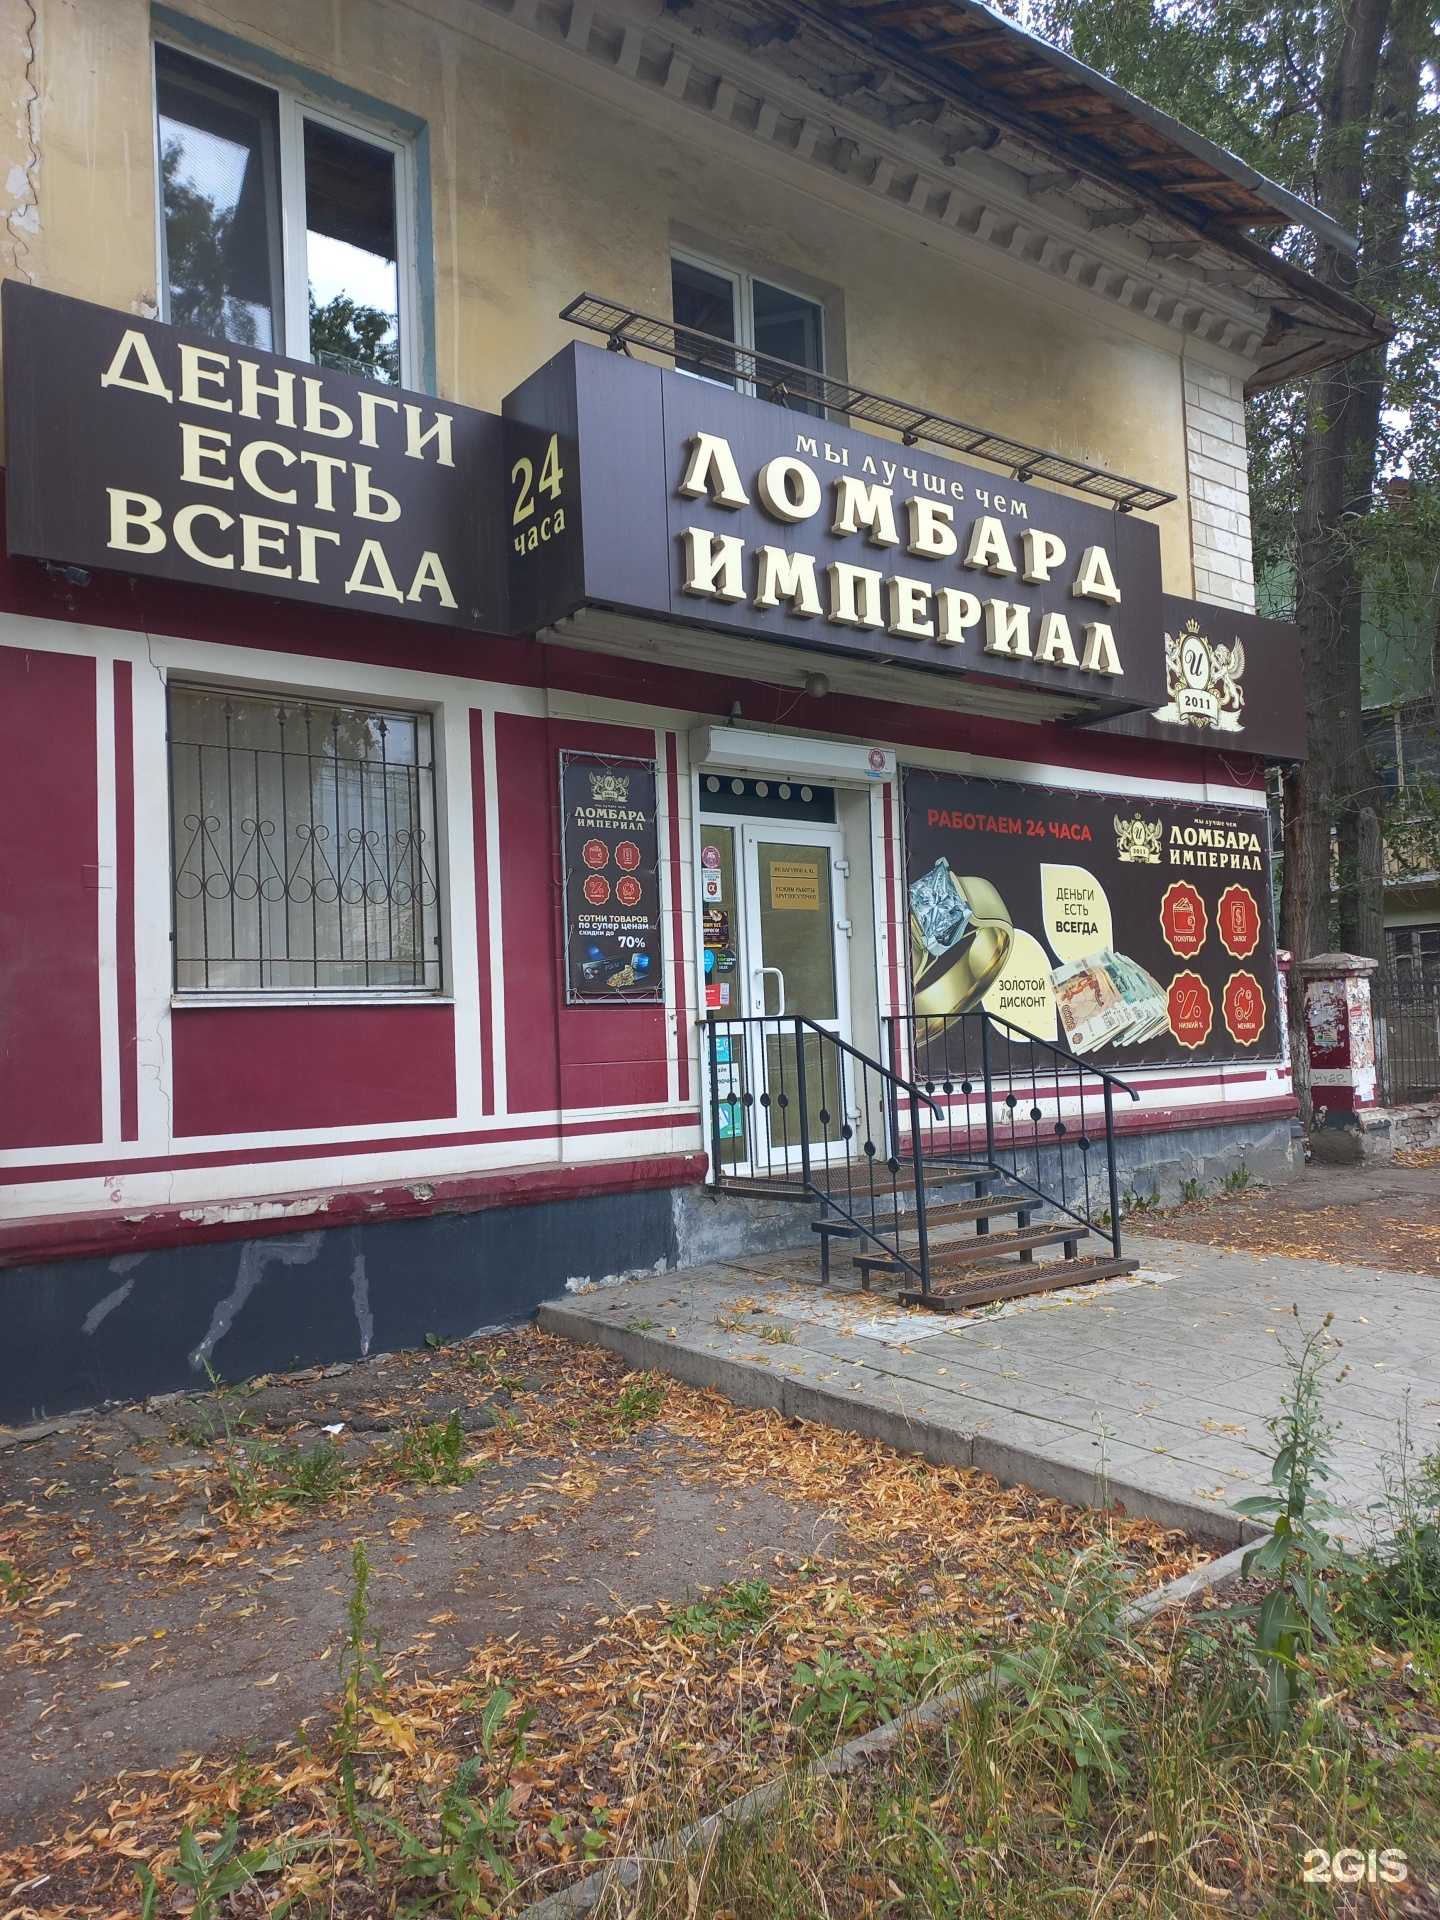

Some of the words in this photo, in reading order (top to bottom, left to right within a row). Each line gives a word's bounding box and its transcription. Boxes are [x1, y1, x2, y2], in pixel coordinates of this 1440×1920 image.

[101, 329, 456, 467] ДЕНЬГИ
[179, 421, 402, 523] ЕСТЬ
[511, 431, 564, 526] 24
[795, 434, 849, 467] мы
[861, 455, 964, 501] лучше
[975, 487, 1029, 520] чем
[678, 431, 1121, 606] ЛОМБАРД
[514, 508, 566, 556] часа
[106, 487, 458, 608] ВСЕГДА
[680, 527, 1125, 677] ИМПЕРИАЛ
[1184, 695, 1211, 710] 2011
[574, 806, 646, 822] ЛОМБАРД
[577, 818, 644, 831] ИМПЕРИАЛ
[927, 808, 1022, 835] РАБОТАЕМ
[1026, 819, 1046, 837] 24
[1049, 822, 1093, 842] ЧАСА
[1169, 825, 1262, 853] ЛОМБАРД
[1169, 848, 1262, 871] ИМПЕРИАЛ
[1056, 888, 1095, 902] ДЕНЬГИ
[1064, 903, 1089, 916] ЕСТЬ
[578, 914, 608, 922] СОТНИ
[609, 915, 649, 923] ТОВАРОВ
[592, 922, 619, 931] супер
[1055, 921, 1099, 935] ВСЕГДА
[618, 936, 646, 948] 70%
[1173, 935, 1197, 943] ПОКУПКА
[1000, 978, 1046, 991] ЗОЛОТОЙ
[1000, 996, 1047, 1009] ДИСКОНТ
